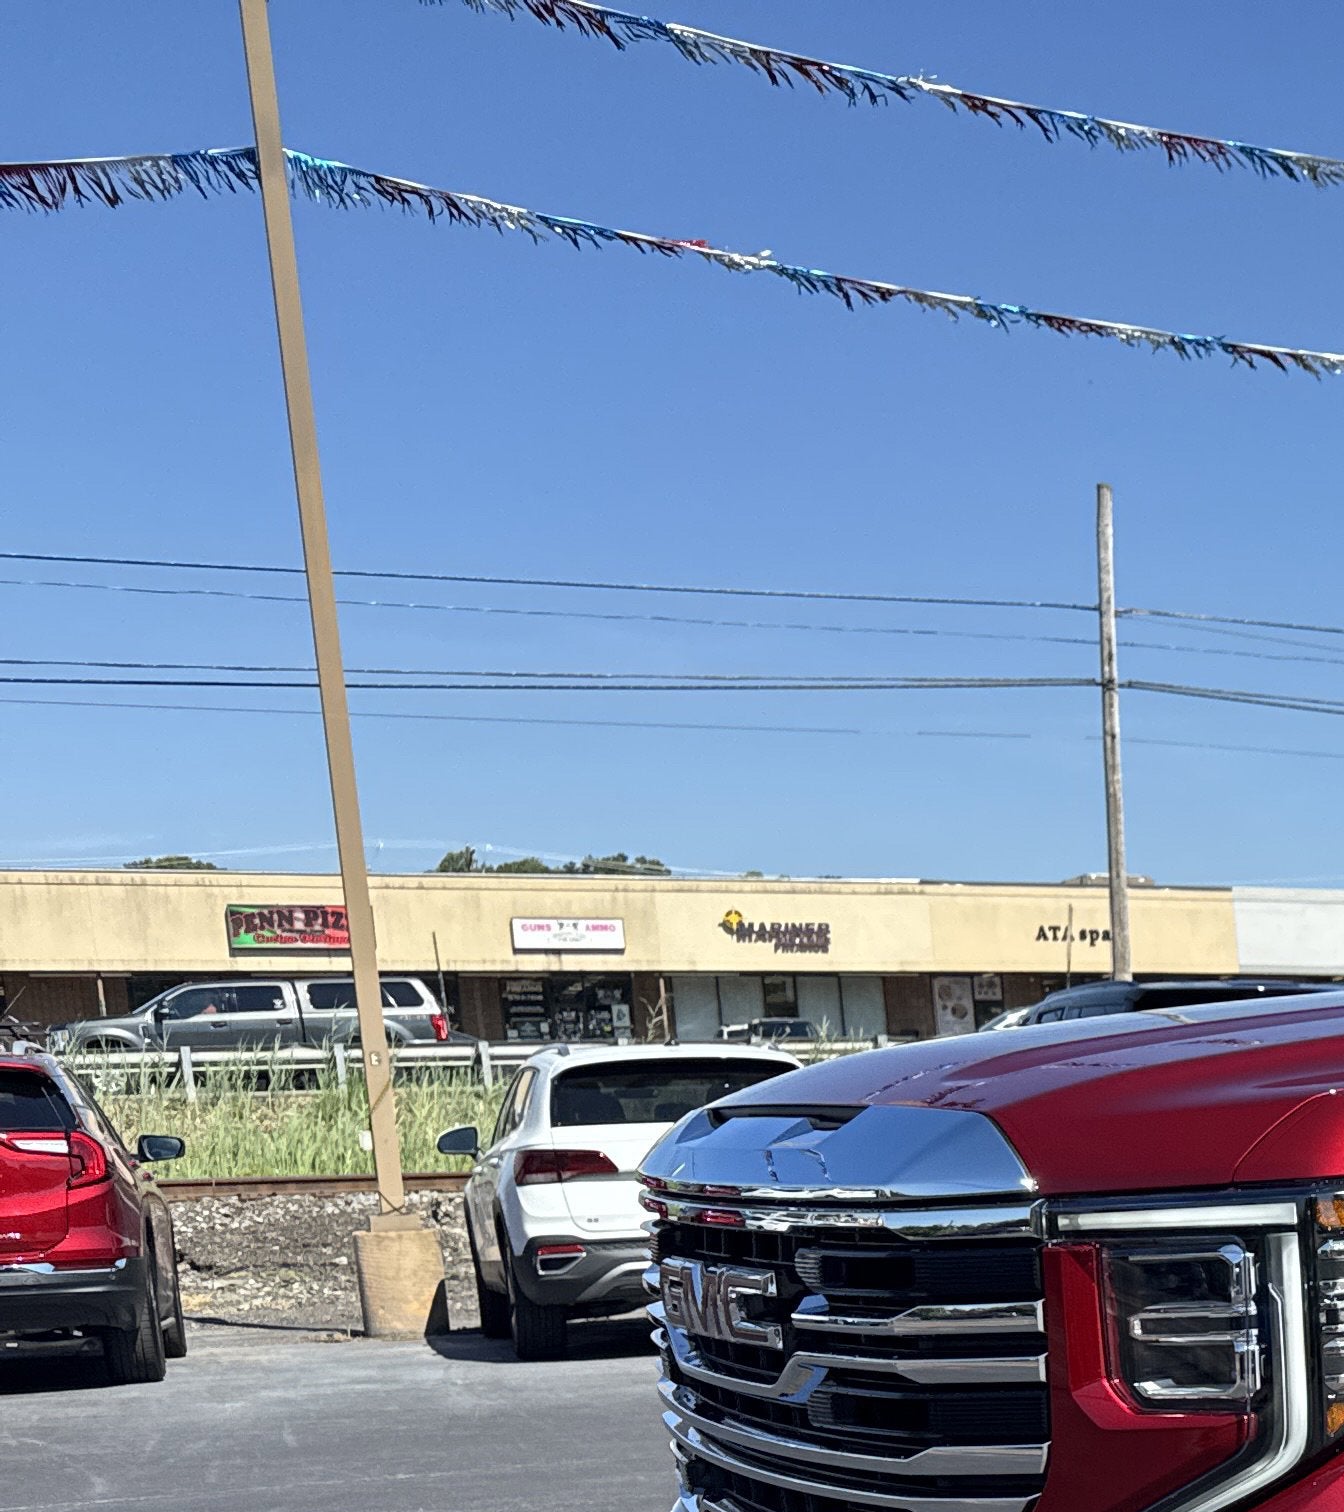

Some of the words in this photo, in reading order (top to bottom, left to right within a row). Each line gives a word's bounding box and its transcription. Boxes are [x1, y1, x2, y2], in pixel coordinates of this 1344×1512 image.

[230, 909, 294, 938] PENN
[304, 909, 347, 931] PIZ
[521, 923, 552, 932] GUNS
[585, 923, 616, 932] AMMO
[736, 922, 830, 940] MARINER
[1035, 925, 1075, 942] ATA
[1079, 928, 1112, 947] spa
[660, 1256, 784, 1350] GMC
